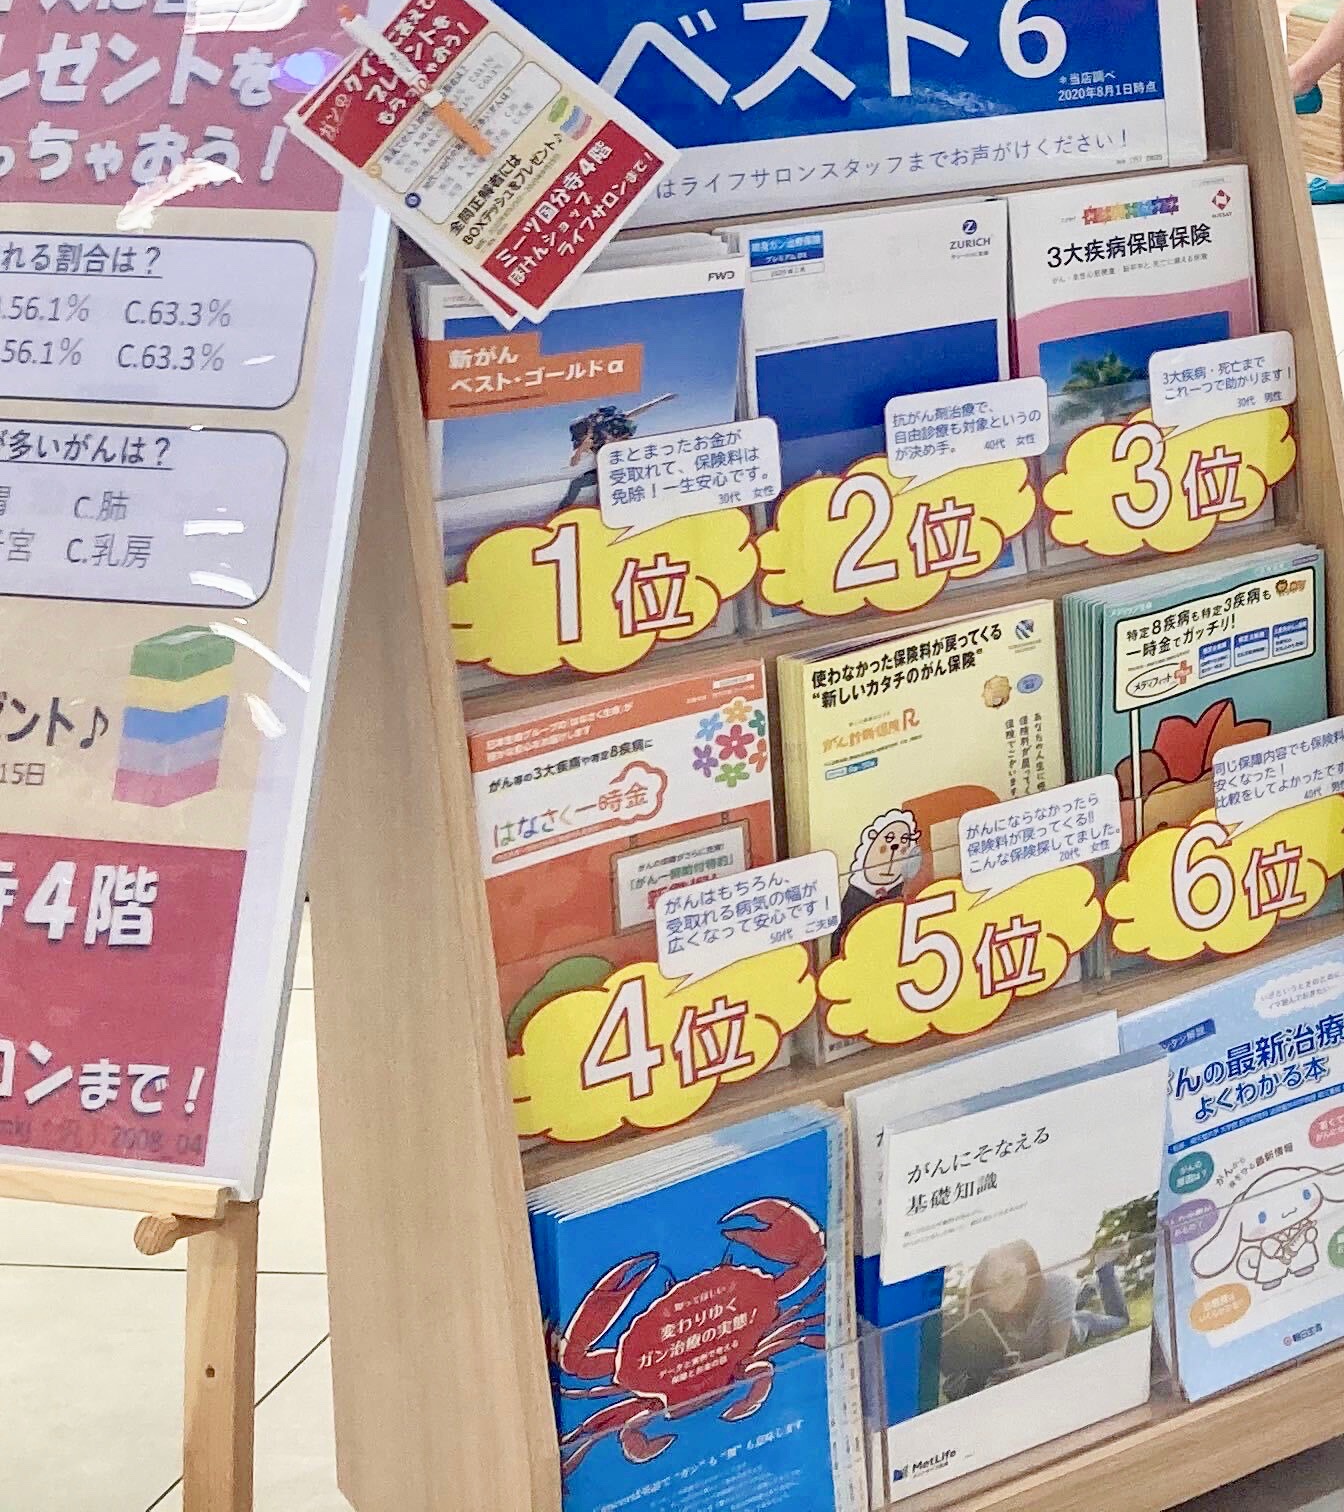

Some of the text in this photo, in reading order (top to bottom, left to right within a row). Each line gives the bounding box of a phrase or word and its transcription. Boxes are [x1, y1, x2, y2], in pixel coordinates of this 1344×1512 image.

[1057, 80, 1158, 103] 2020年8月1日時点
[949, 236, 992, 251] ZURICH
[1046, 223, 1213, 268] 3大疾病保障保険
[707, 270, 736, 282] FWD
[447, 345, 520, 370] 新がん
[1162, 355, 1266, 386] 3大疾病・死亡まで
[892, 401, 995, 429] 抗がん剤治療で、
[894, 409, 1042, 445] 自由診療も対象というの
[609, 428, 742, 466] まとまったお金が
[609, 446, 761, 487] 受取れて、保険料は
[895, 439, 957, 462] が決め手。
[1111, 422, 1246, 531] 3位
[73, 490, 130, 522] C.肺
[65, 532, 155, 569] C.乳房
[829, 474, 981, 592] 2位
[532, 524, 694, 644] 1位
[1125, 587, 1273, 643] 特定8疾病も特定3疾病も
[811, 623, 1002, 690] 使わなかった保険料が戻ってくる
[494, 781, 650, 849] はなさく一時金
[966, 793, 1099, 841] がんにならなかったら
[969, 823, 1121, 874] こんな保険探してました。
[664, 871, 790, 916] がんはもちろん、
[1170, 819, 1308, 932] 6位
[666, 879, 818, 937] 受取れる病気の幅が
[897, 890, 1046, 1013] 5位
[581, 976, 757, 1101] 4位
[1193, 1055, 1331, 1123] よくわかる本
[906, 1125, 1051, 1185] がんにそなえる
[904, 1171, 999, 1218] 基礎知識
[660, 1297, 738, 1342] 変わりゆく
[911, 1448, 957, 1474] MetLife
